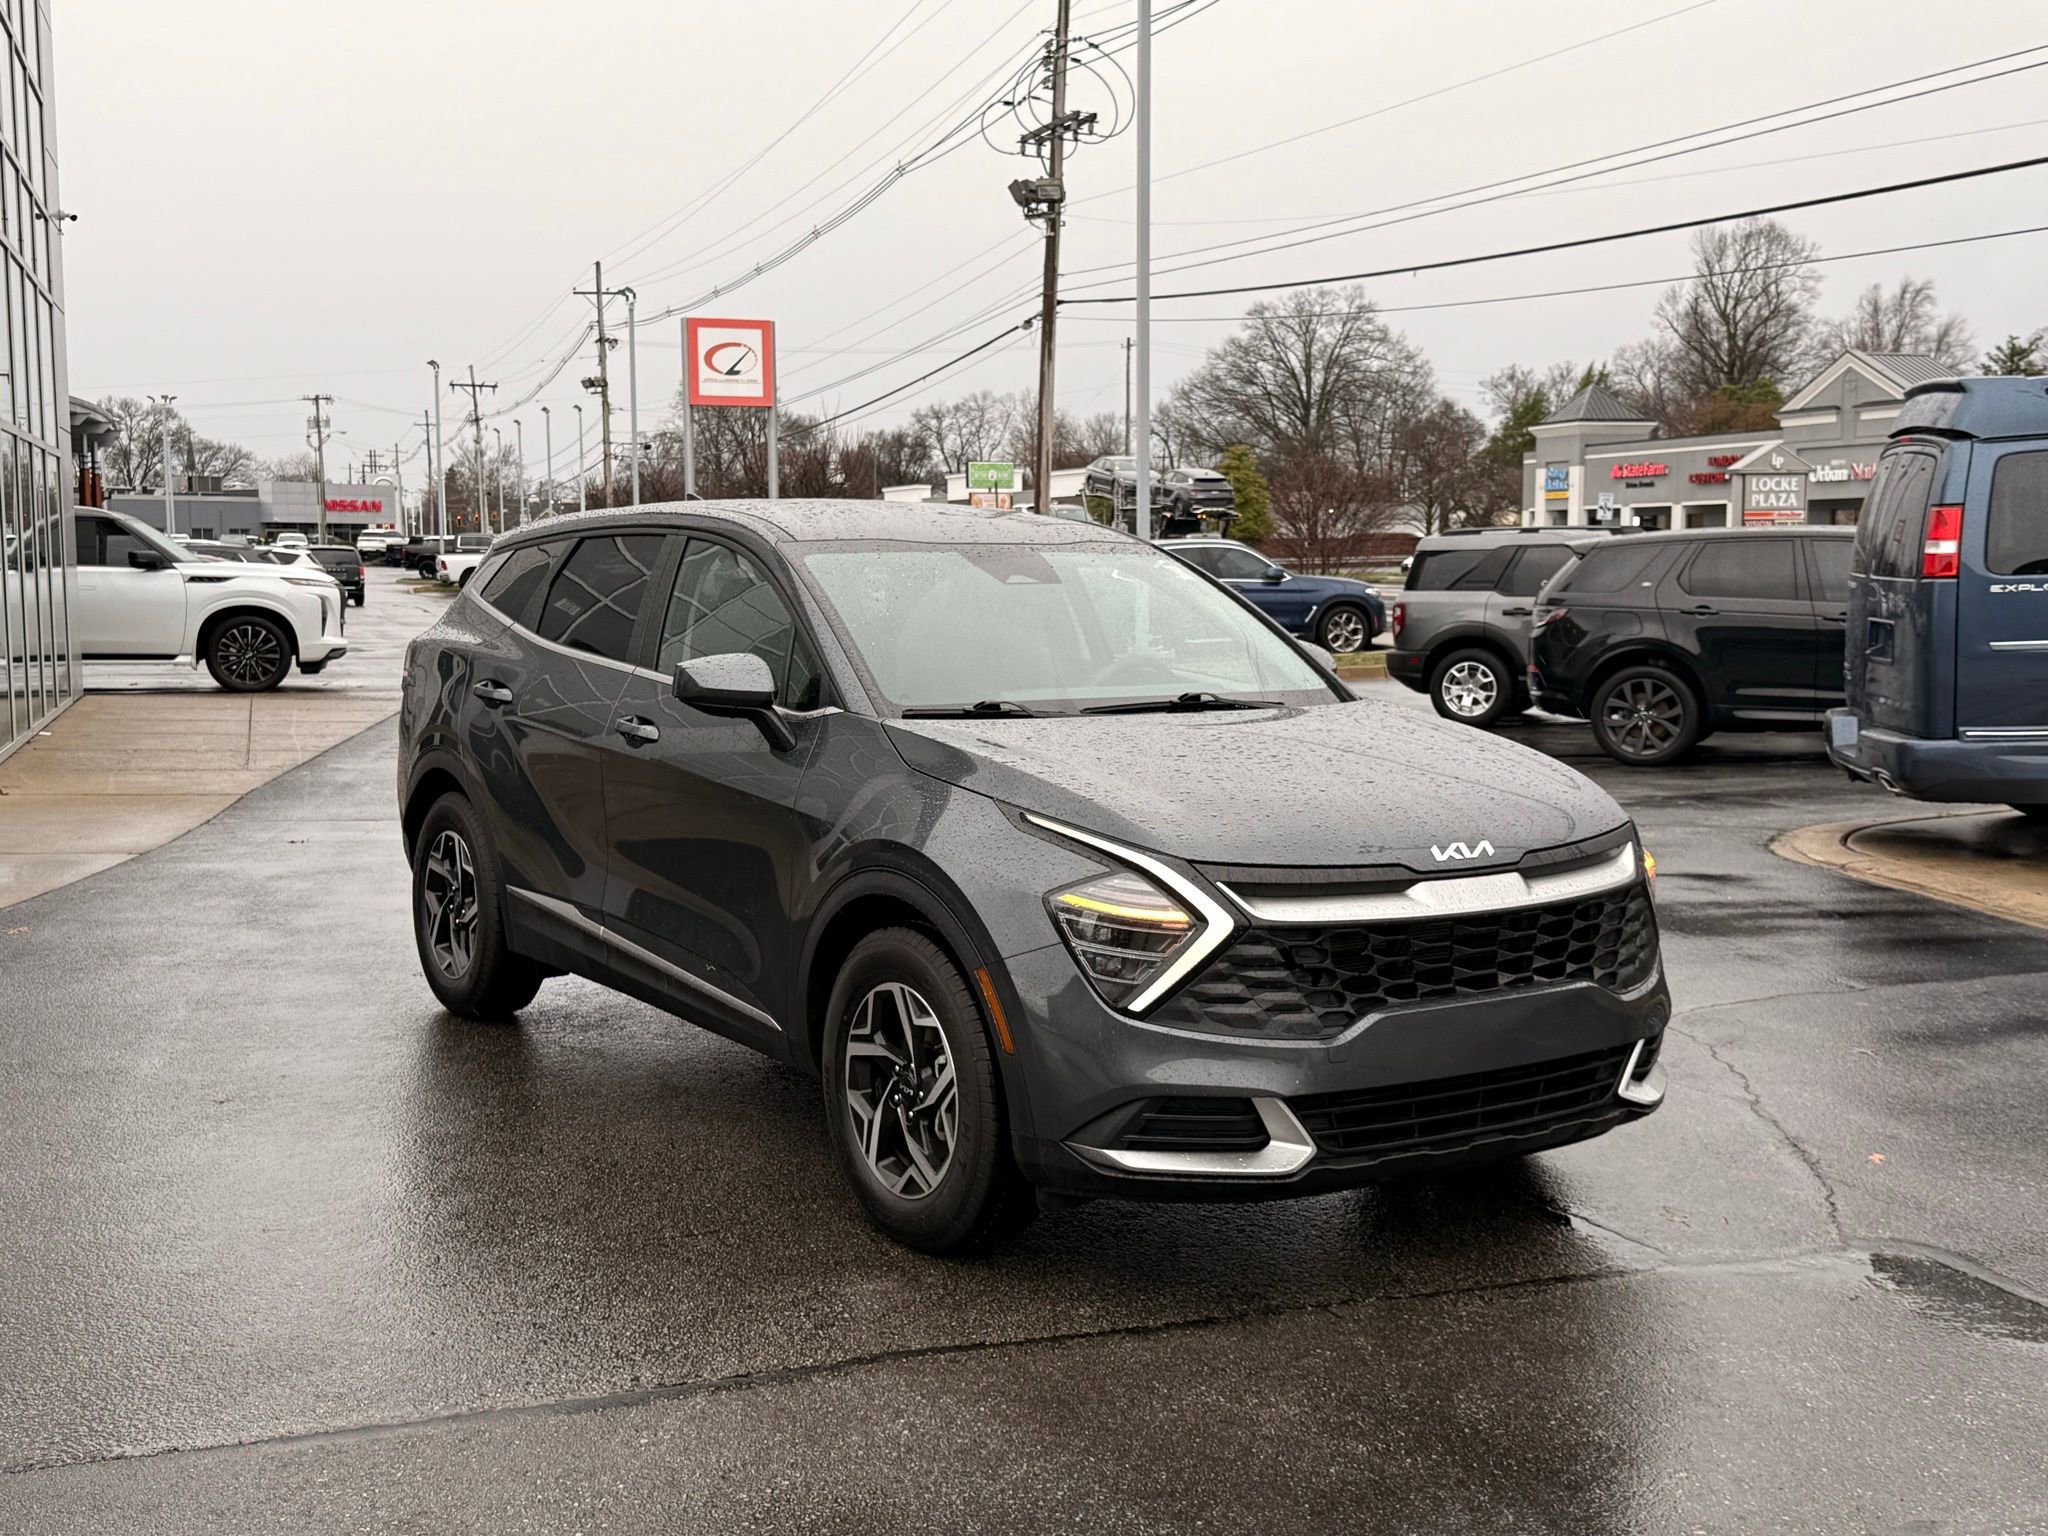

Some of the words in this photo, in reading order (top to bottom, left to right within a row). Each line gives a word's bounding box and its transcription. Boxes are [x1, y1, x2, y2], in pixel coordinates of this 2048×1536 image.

[1751, 477, 1800, 492] LOCKE
[324, 499, 382, 513] NISSAN
[1751, 493, 1798, 507] PLAZA
[1430, 840, 1495, 862] KIA
